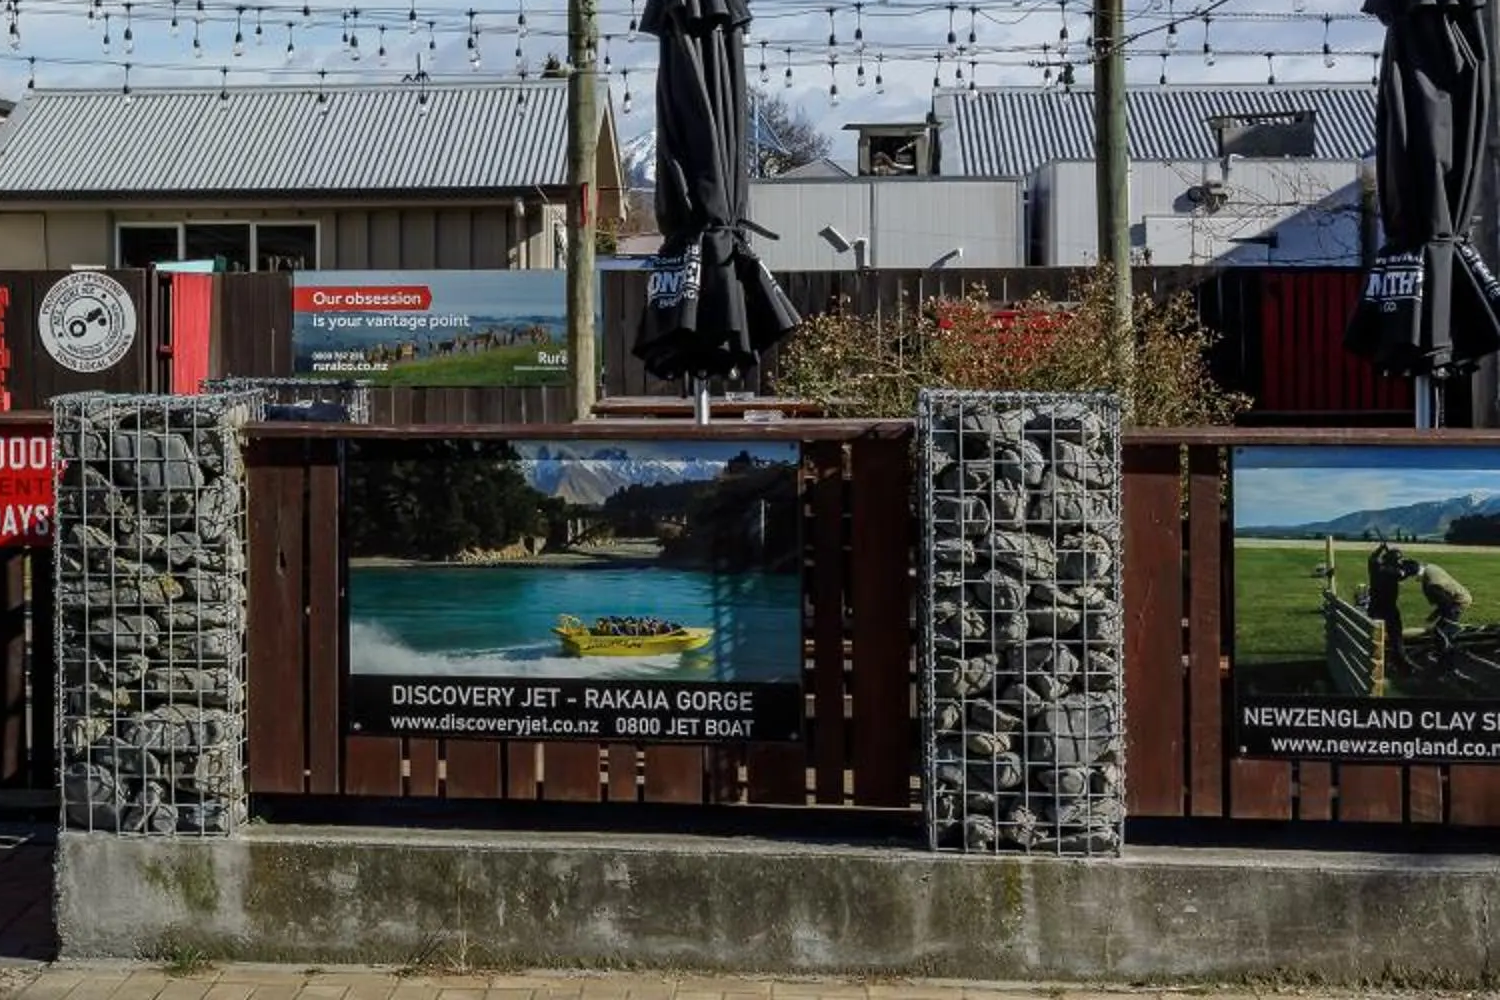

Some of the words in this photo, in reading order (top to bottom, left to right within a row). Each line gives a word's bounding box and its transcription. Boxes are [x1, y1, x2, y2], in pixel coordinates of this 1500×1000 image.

[313, 291, 341, 306] Our
[345, 291, 422, 306] obsession
[313, 313, 325, 327] is
[328, 316, 362, 331] your
[366, 315, 427, 330] vantage
[429, 313, 471, 330] point
[538, 351, 569, 365] Rura
[391, 685, 515, 708] DISCOVERY
[521, 687, 561, 709] JET
[585, 688, 670, 711] RAKAIA
[677, 691, 754, 712] GORGE
[391, 713, 599, 736] www.discoveryjet.co.nz
[616, 717, 661, 735] 0800
[665, 718, 701, 736] JET
[705, 719, 754, 737] BOAT
[1243, 706, 1413, 729] NEWZENGLAND
[1421, 711, 1477, 731] CLAY
[1482, 711, 1500, 731] S
[1271, 736, 1500, 759] www.newzengland.co.n
